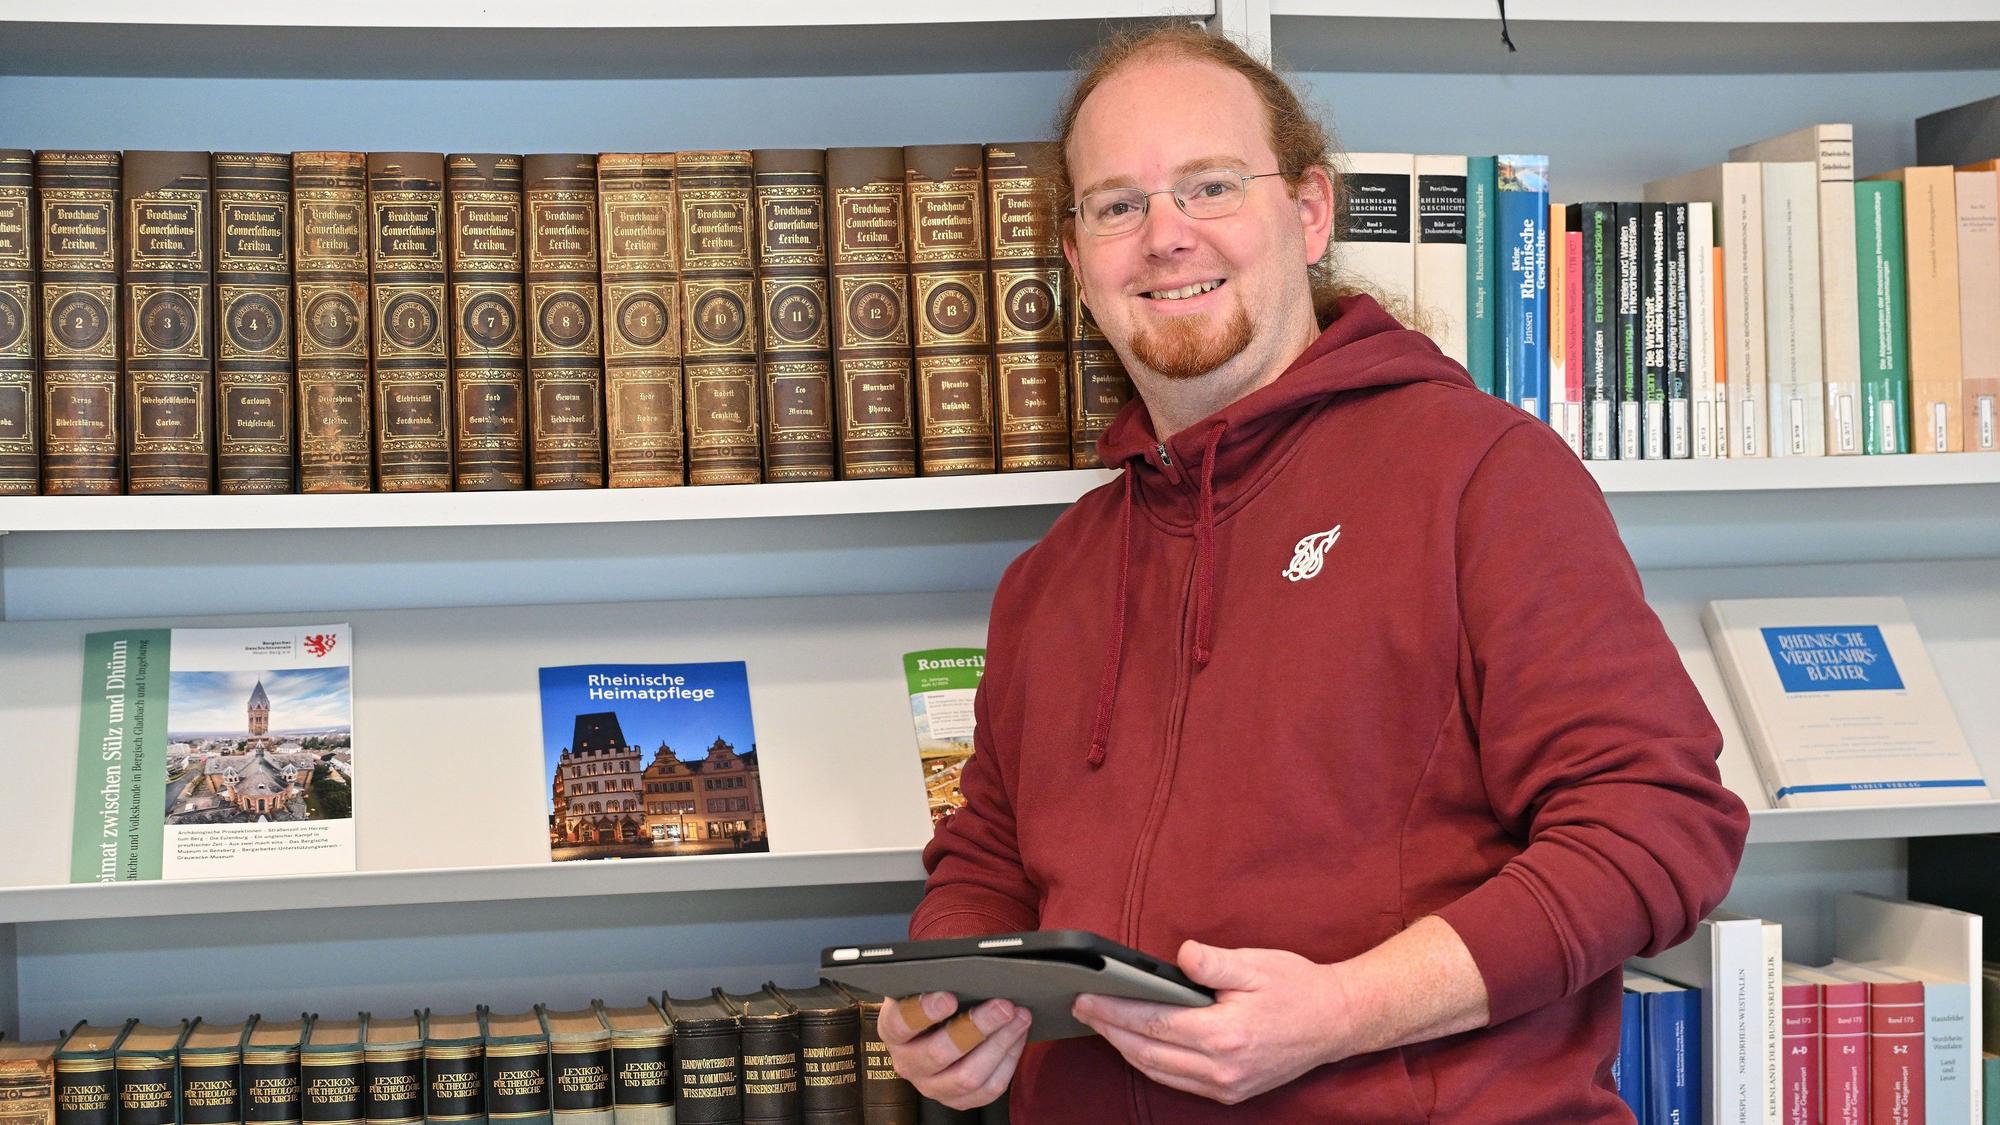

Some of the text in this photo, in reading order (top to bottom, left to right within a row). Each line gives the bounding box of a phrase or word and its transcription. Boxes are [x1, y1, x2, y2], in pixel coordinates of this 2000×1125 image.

[1476, 183, 1487, 244] Kirchengeschichte
[1594, 210, 1604, 265] Landeskunde
[1512, 246, 1520, 271] Kleine
[1520, 218, 1535, 299] Rheinische
[1535, 229, 1546, 290] Geschichte
[1629, 217, 1638, 315] in Nordrhein-Westfalen
[1620, 225, 1630, 315] Parteien und Wahlen
[1594, 266, 1604, 305] politische
[1654, 211, 1664, 368] des Landes Nordrhein-Westfalen
[1677, 206, 1687, 373] im Rheinland und in Westfalen 1933 1945
[791, 310, 802, 322] 11
[945, 304, 957, 317] 13
[1594, 305, 1603, 323] Eine
[1668, 261, 1678, 373] Verfolgung und Widerstand
[75, 317, 84, 329] 2
[249, 318, 258, 331] 4
[407, 317, 415, 329] 6
[1524, 311, 1535, 346] Janssen
[1645, 296, 1655, 367] Die Wirtschaft
[1623, 354, 1633, 393] Alemann
[1777, 632, 1867, 650] RHEINISCHE
[588, 673, 685, 686] Rheinische
[589, 686, 715, 702] Heimatpflege
[96, 639, 127, 887] eimat zwischen Sülz und Dhünn
[127, 639, 149, 881] hichte und Volkskunde in Bergisch Gladbach und Umgebung
[1886, 781, 1920, 789] VERLAG
[1738, 969, 1746, 1075] NORDRHEIN-WESTFALEN
[1767, 956, 1777, 1117] KERNLAND DER BUNDESREPUBLIK
[681, 1056, 735, 1070] HANDWÖRTERBUCH
[1940, 1058, 1956, 1066] Land
[499, 1069, 540, 1080] LEXIKON
[564, 1066, 604, 1076] LEXIKON
[572, 1074, 608, 1084] THEOLOGIE
[684, 1071, 737, 1085] DER KOMMUNAL-
[1939, 1074, 1956, 1082] Leute
[125, 1083, 166, 1093] LEXIKON
[189, 1080, 232, 1090] LEXIKON
[507, 1077, 545, 1087] THEOLOGIE
[563, 1083, 606, 1092] UND KIRCHE
[1800, 1066, 1808, 1106] Gegenwart
[1850, 1066, 1858, 1106] Gegenwart
[1901, 1066, 1910, 1106] Gegenwart
[131, 1091, 172, 1100] THEOLOGIE
[197, 1088, 237, 1098] THEOLOGIE
[498, 1086, 541, 1096] UND KIRCHE
[140, 1100, 168, 1109] KIRCHE
[206, 1097, 233, 1106] KIRCHE
